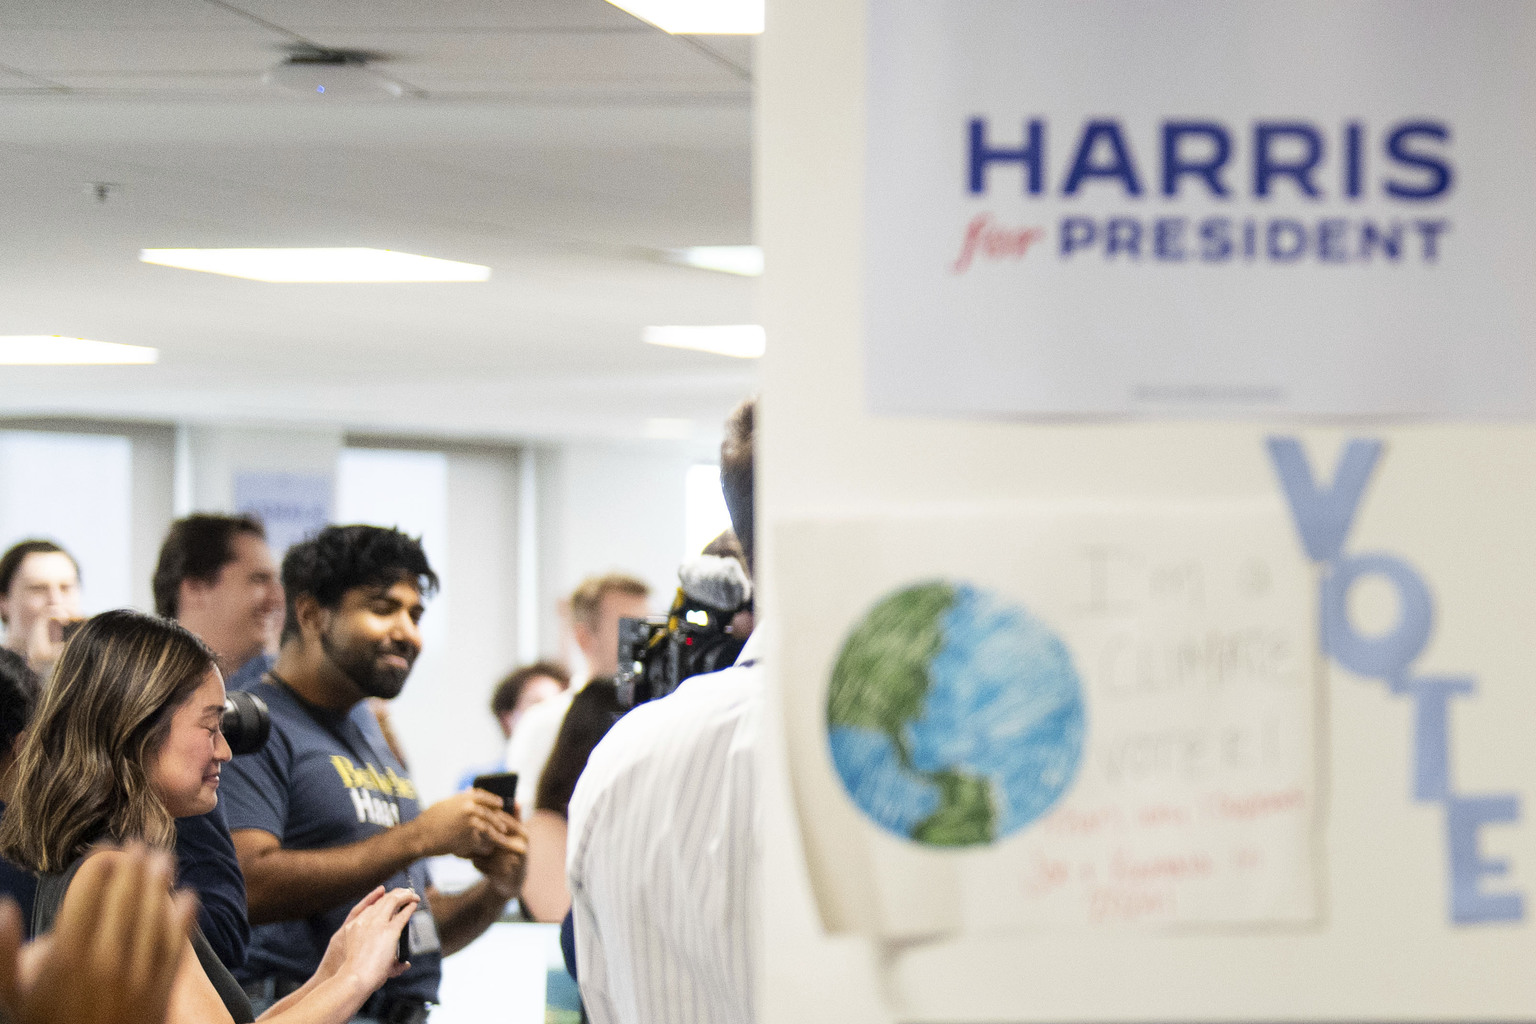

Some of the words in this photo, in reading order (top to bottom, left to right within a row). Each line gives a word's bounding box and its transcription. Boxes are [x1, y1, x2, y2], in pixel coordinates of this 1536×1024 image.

[964, 115, 1457, 202] HARRIS
[955, 212, 1043, 273] for
[1057, 215, 1452, 265] PRESIDENT
[1264, 435, 1527, 927] VOTE
